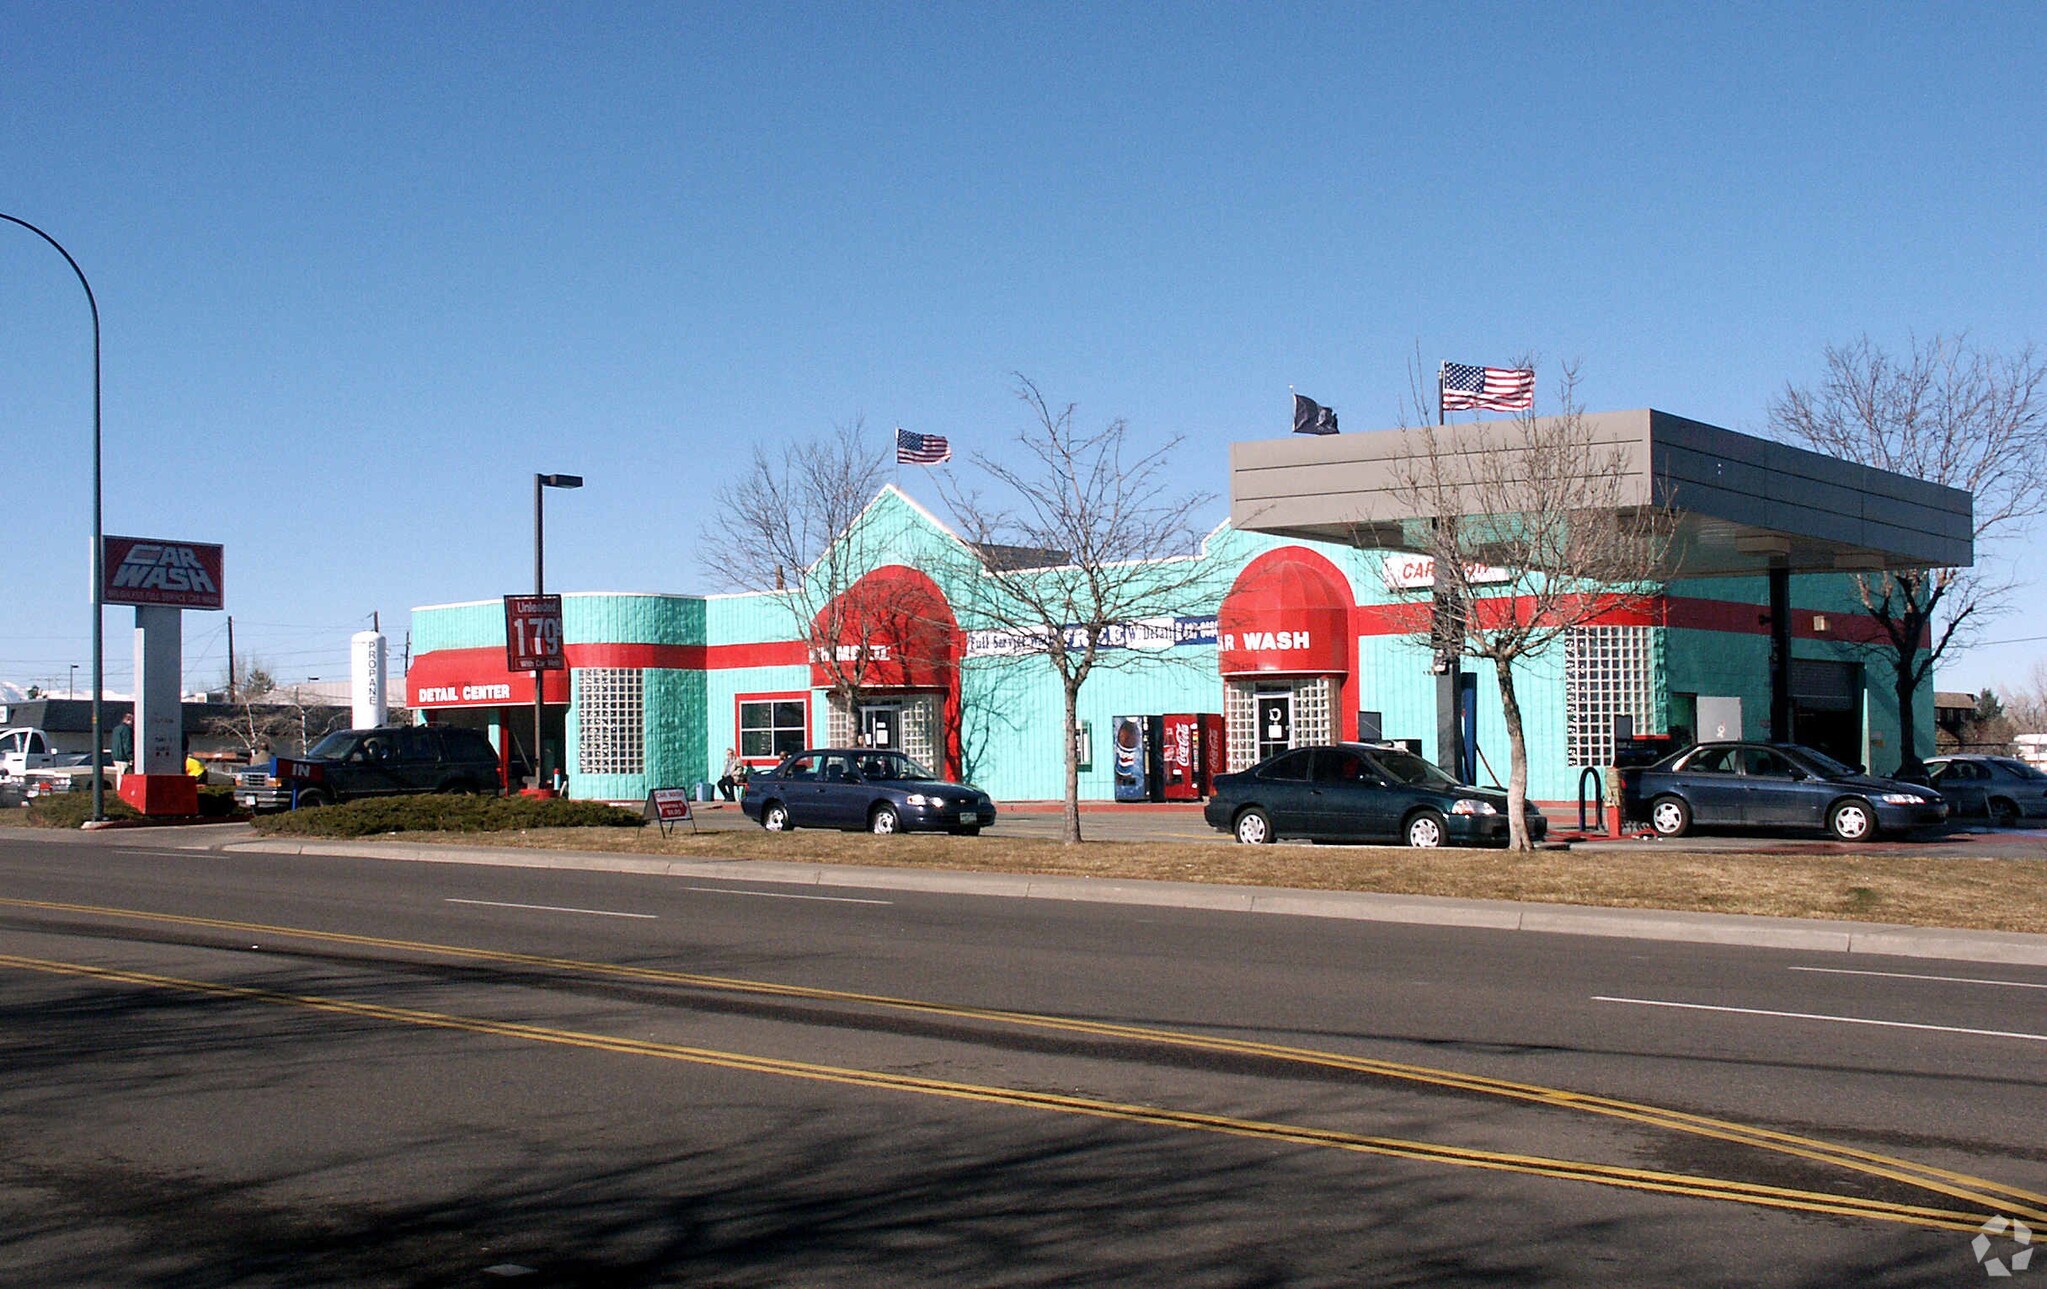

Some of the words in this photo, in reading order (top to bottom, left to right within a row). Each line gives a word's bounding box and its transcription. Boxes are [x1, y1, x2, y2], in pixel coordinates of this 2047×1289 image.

[122, 544, 205, 571] CAR
[112, 563, 217, 594] WASH
[1402, 560, 1436, 580] CAR
[517, 601, 556, 614] Unleaded
[1242, 630, 1311, 651] WASH
[367, 641, 378, 706] PROPANE
[418, 685, 459, 703] DETAIL
[462, 684, 511, 700] CENTER
[291, 762, 311, 778] IN
